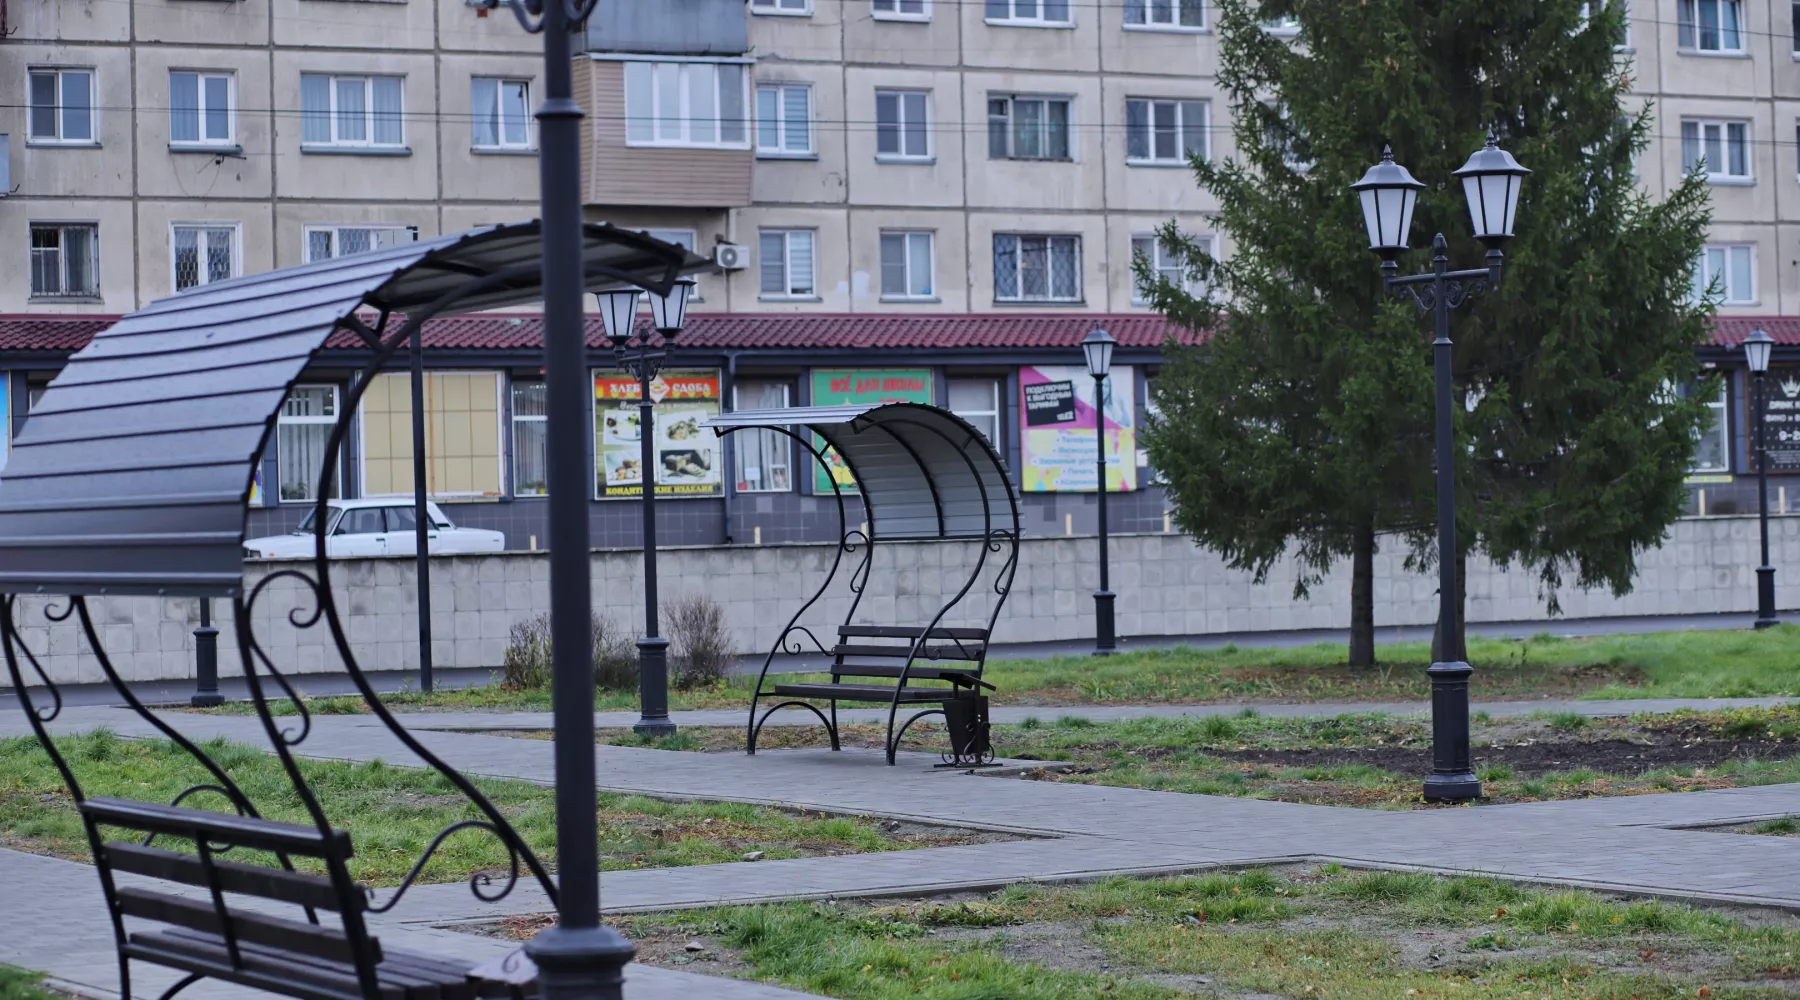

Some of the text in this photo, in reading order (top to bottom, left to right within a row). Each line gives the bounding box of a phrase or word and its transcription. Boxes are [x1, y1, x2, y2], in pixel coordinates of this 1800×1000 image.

[610, 383, 641, 393] ХЛЕБ
[672, 383, 711, 393] СДОБА
[855, 377, 878, 394] ДЛЯ
[882, 377, 925, 392] ШКОЛЫ
